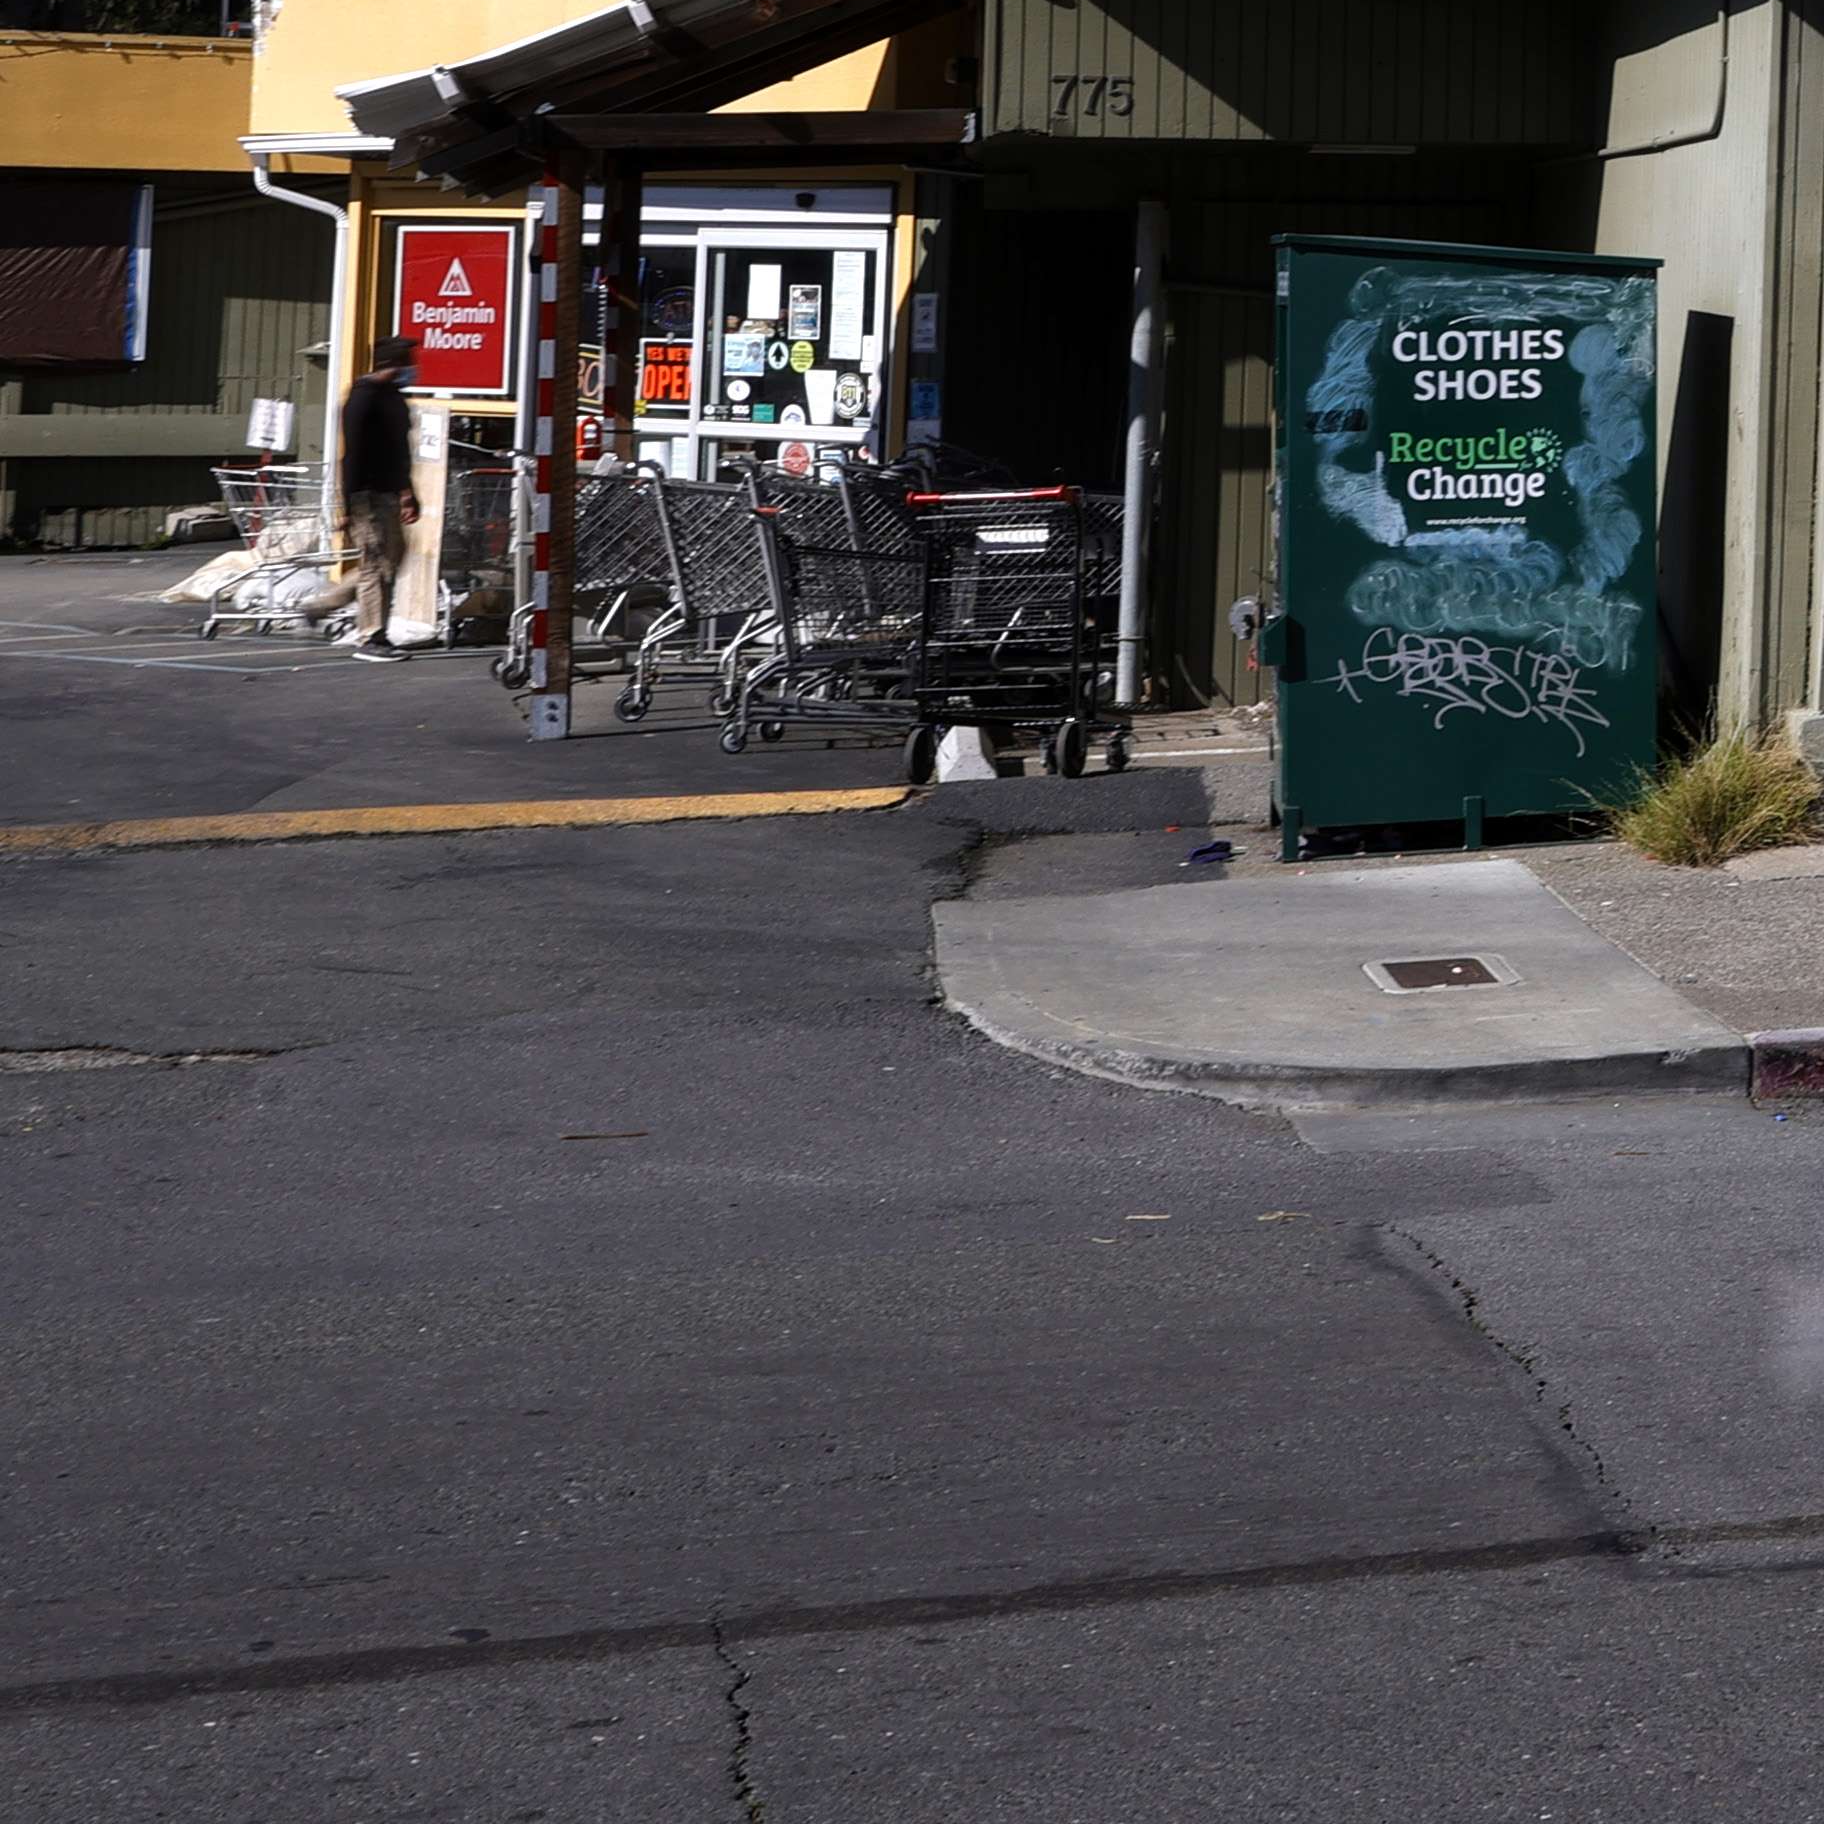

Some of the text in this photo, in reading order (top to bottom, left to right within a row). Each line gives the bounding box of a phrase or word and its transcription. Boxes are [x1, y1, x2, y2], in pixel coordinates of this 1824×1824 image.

[1050, 74, 1134, 117] 775
[412, 300, 495, 329] Benjamin
[423, 328, 482, 350] Moore
[1392, 329, 1565, 362] CLOTHES
[1413, 368, 1543, 401] SHOES
[1389, 428, 1527, 469] Recycle
[1407, 466, 1546, 507] Change
